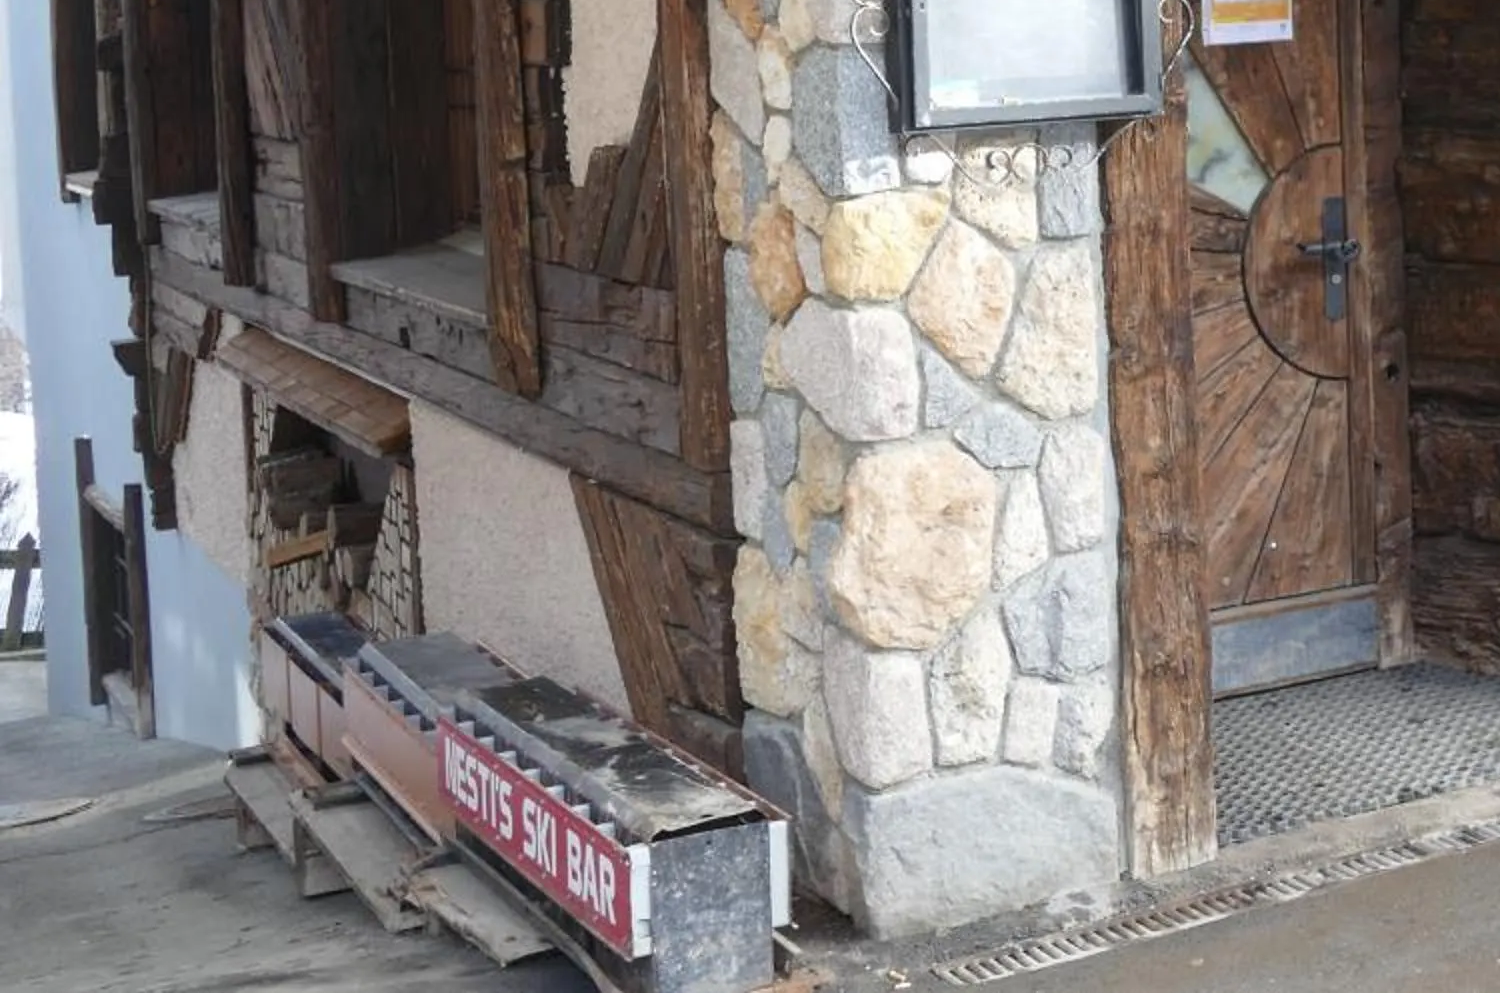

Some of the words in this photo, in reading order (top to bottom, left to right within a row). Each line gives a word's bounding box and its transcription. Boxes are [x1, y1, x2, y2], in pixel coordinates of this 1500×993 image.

[444, 735, 514, 840] NESTI'S
[522, 797, 558, 878] SKI
[566, 828, 617, 926] BAR
